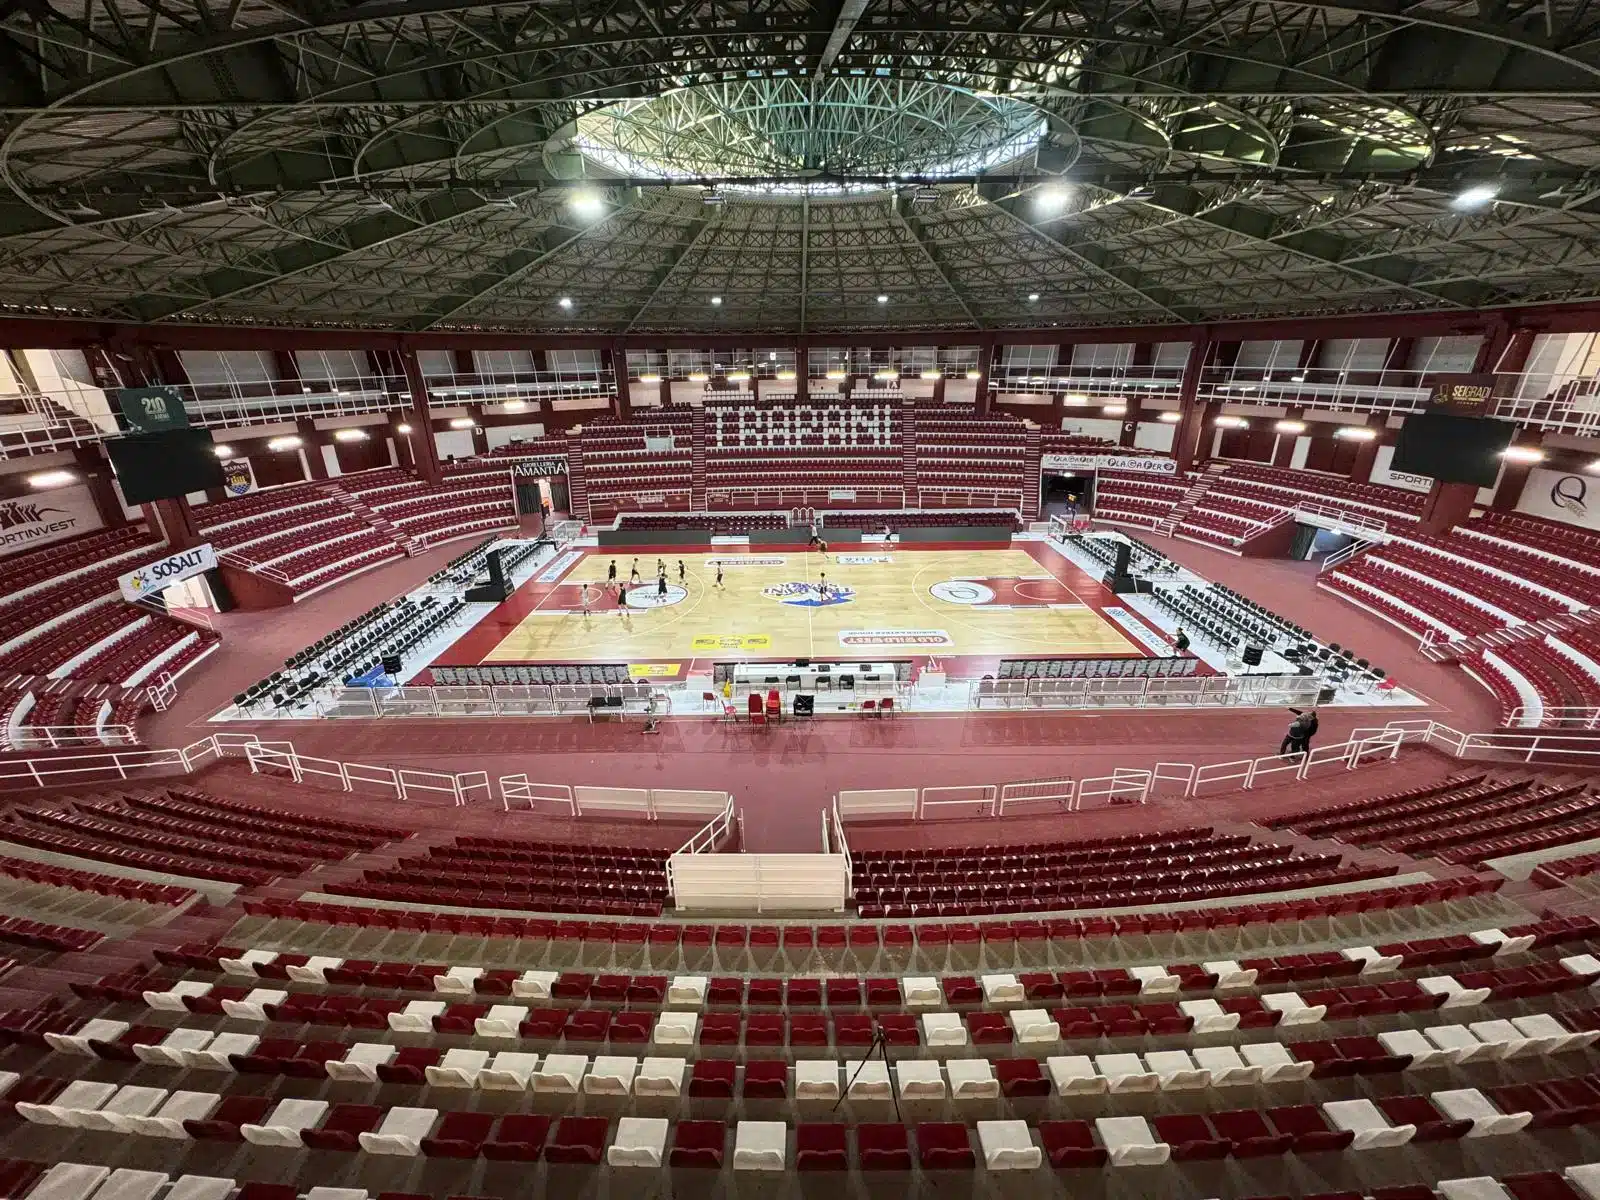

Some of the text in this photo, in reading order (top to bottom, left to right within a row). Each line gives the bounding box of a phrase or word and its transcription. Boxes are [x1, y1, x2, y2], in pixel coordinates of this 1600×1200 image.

[475, 427, 483, 436] D
[1125, 423, 1133, 432] C
[514, 462, 567, 477] AMANTIA
[1389, 472, 1434, 487] SPORTI
[152, 549, 204, 581] SOSALT
